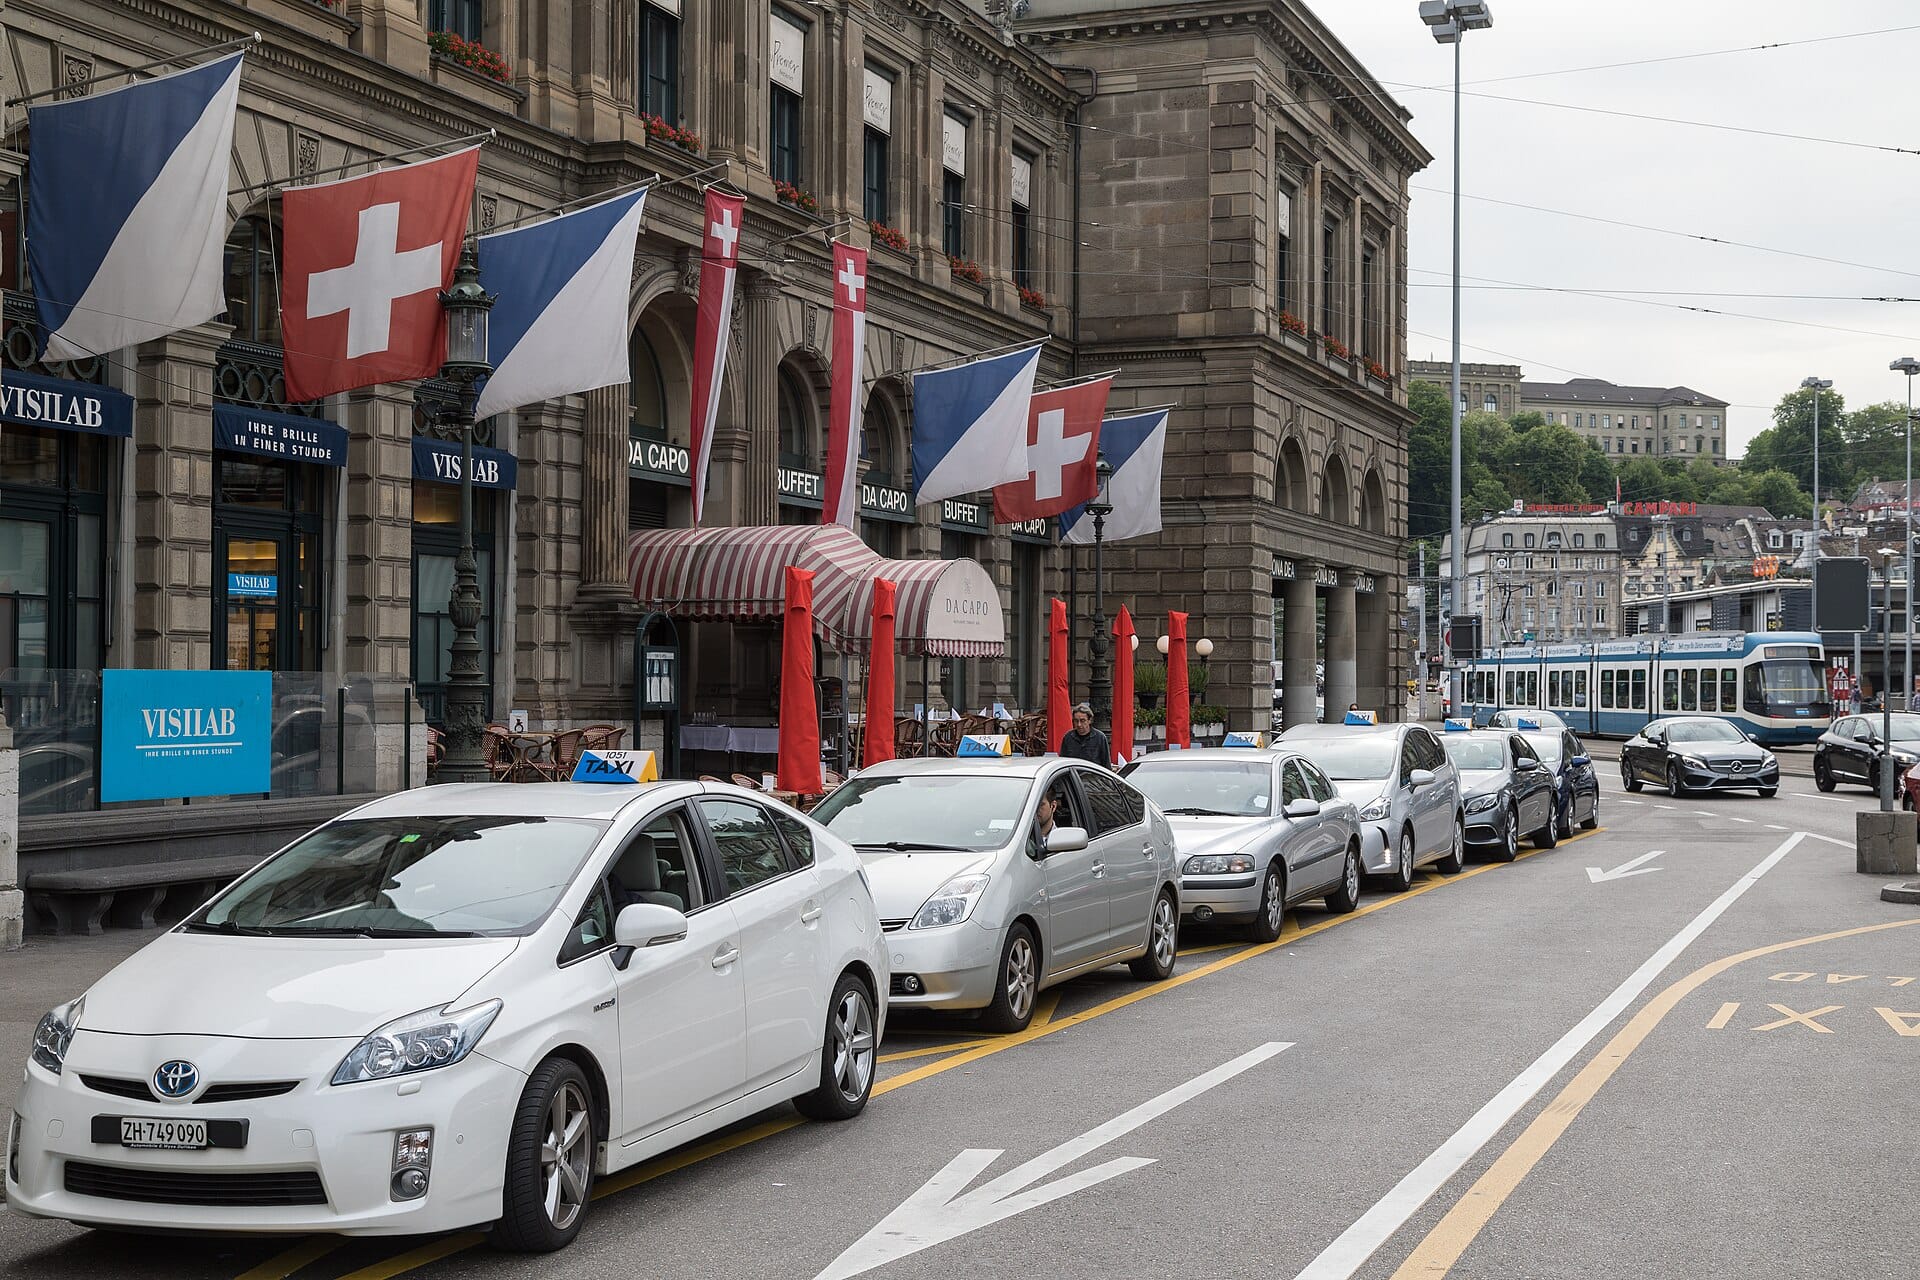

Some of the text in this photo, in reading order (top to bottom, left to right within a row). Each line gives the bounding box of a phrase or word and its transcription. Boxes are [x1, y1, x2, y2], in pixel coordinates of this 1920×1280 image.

[0, 384, 103, 428] VISILAB
[248, 421, 318, 443] IHRE BRILLE
[234, 434, 332, 459] IN EINER STUNDE
[432, 453, 499, 483] VISLAB
[648, 443, 689, 474] CAPO
[862, 485, 907, 512] DA CAPO
[1623, 502, 1697, 515] CAMPARI
[944, 500, 979, 523] BUFFET
[1271, 559, 1283, 577] ONA
[235, 576, 270, 588] VISILAB
[946, 598, 989, 616] DA CAPO
[141, 707, 236, 738] VISILAB
[966, 742, 998, 752] TAXI
[1231, 736, 1254, 744] TAXI
[605, 751, 627, 759] 1051
[585, 760, 635, 774] TAXI
